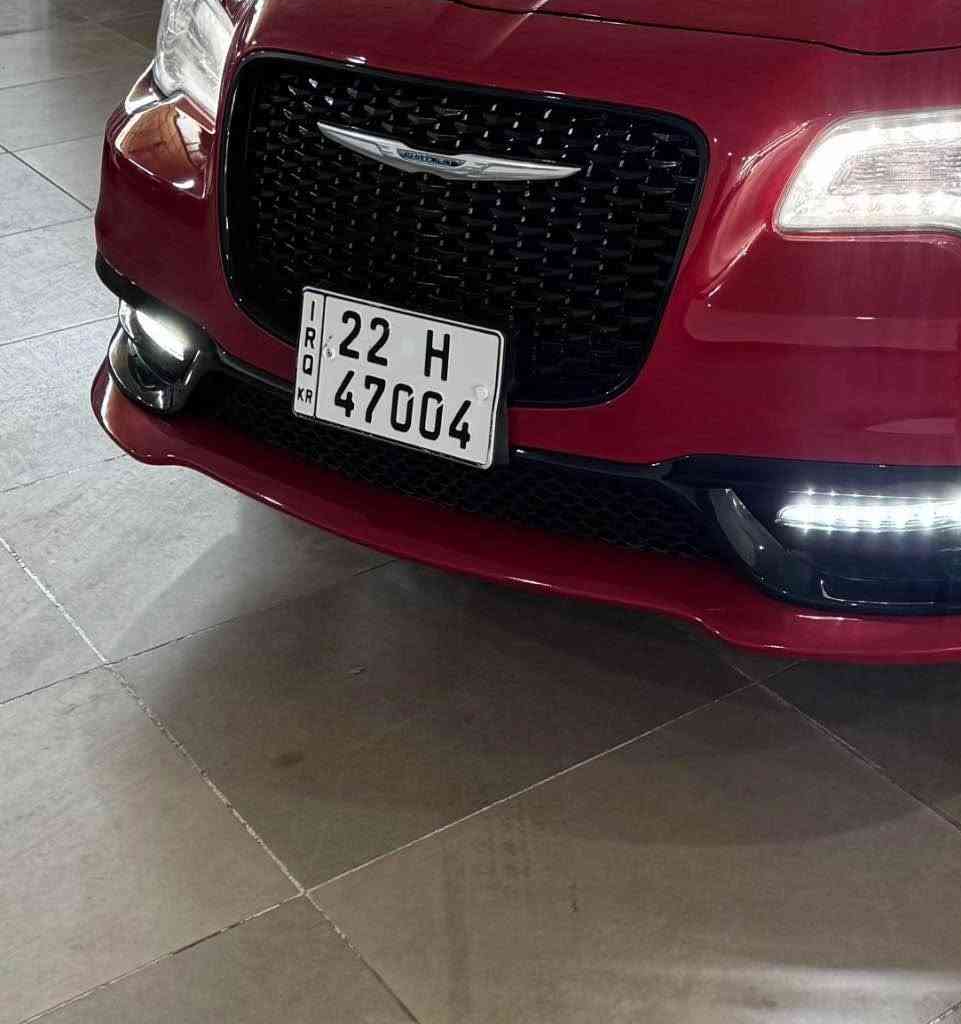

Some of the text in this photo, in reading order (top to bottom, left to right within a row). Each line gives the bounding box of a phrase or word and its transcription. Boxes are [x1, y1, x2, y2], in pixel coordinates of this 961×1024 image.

[302, 300, 316, 376] IRQ
[338, 310, 451, 382] 22 H
[297, 387, 314, 404] KR
[334, 370, 472, 450] 47004
